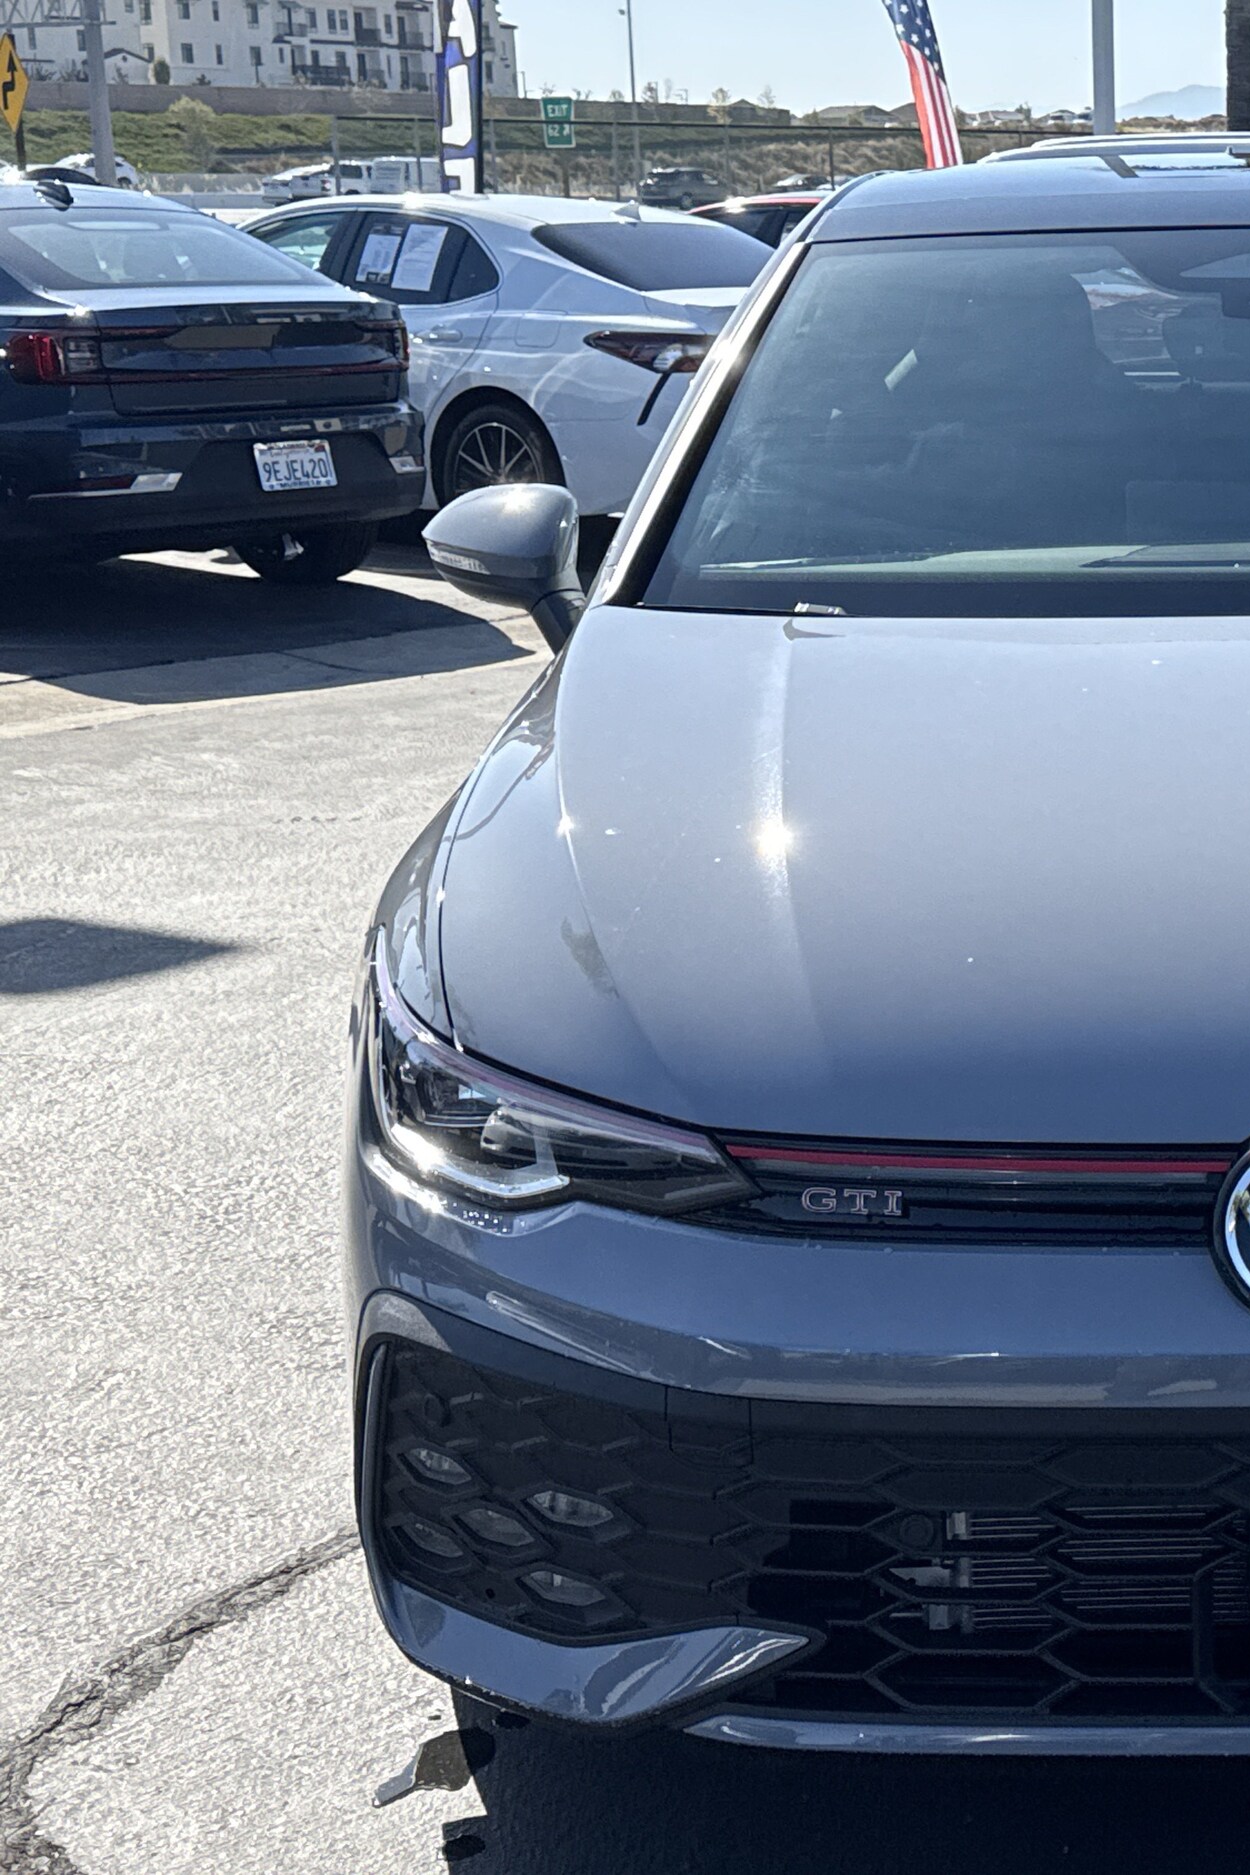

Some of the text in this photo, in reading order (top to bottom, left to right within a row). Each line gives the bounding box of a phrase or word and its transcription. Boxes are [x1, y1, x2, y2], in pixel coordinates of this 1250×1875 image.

[547, 104, 569, 117] EXIT
[548, 124, 560, 137] 62
[262, 457, 329, 482] 9EJE420
[801, 1186, 903, 1216] GTI
